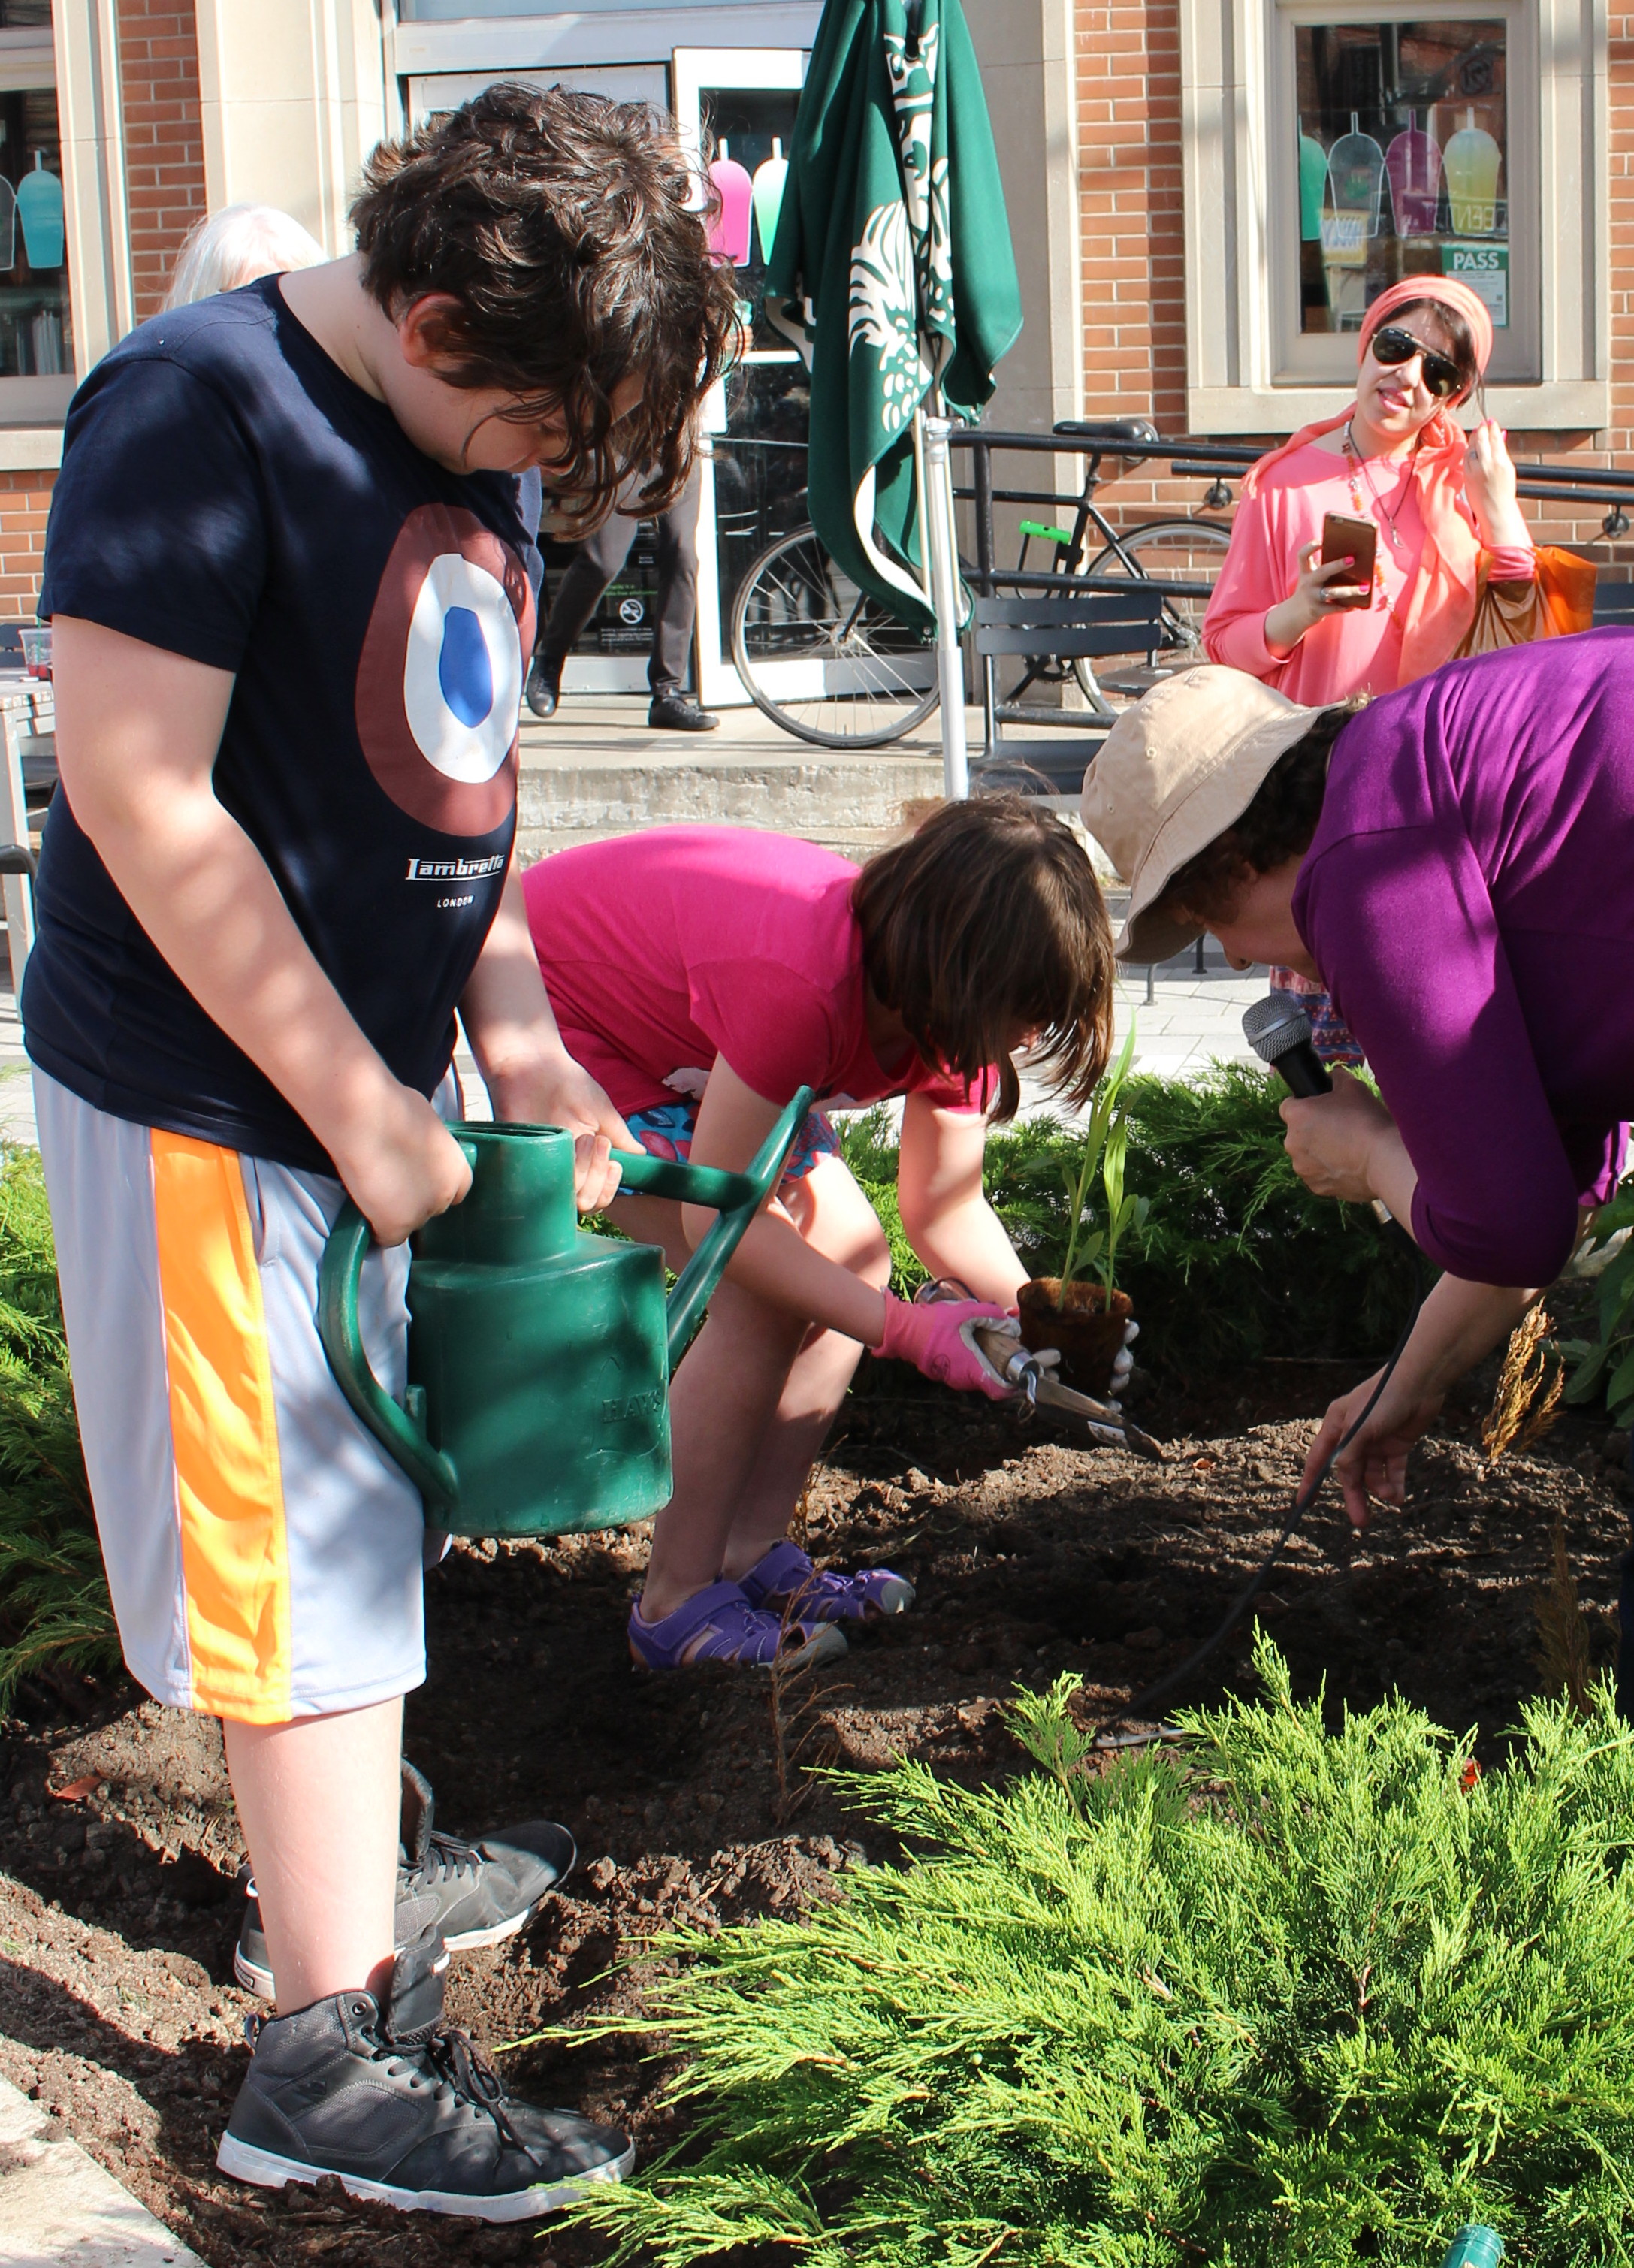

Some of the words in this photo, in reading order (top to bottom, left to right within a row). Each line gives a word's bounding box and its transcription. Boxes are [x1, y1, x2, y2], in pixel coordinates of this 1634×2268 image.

[1453, 252, 1499, 270] PASS
[405, 854, 505, 881] Lambretta
[436, 895, 474, 908] LONDON
